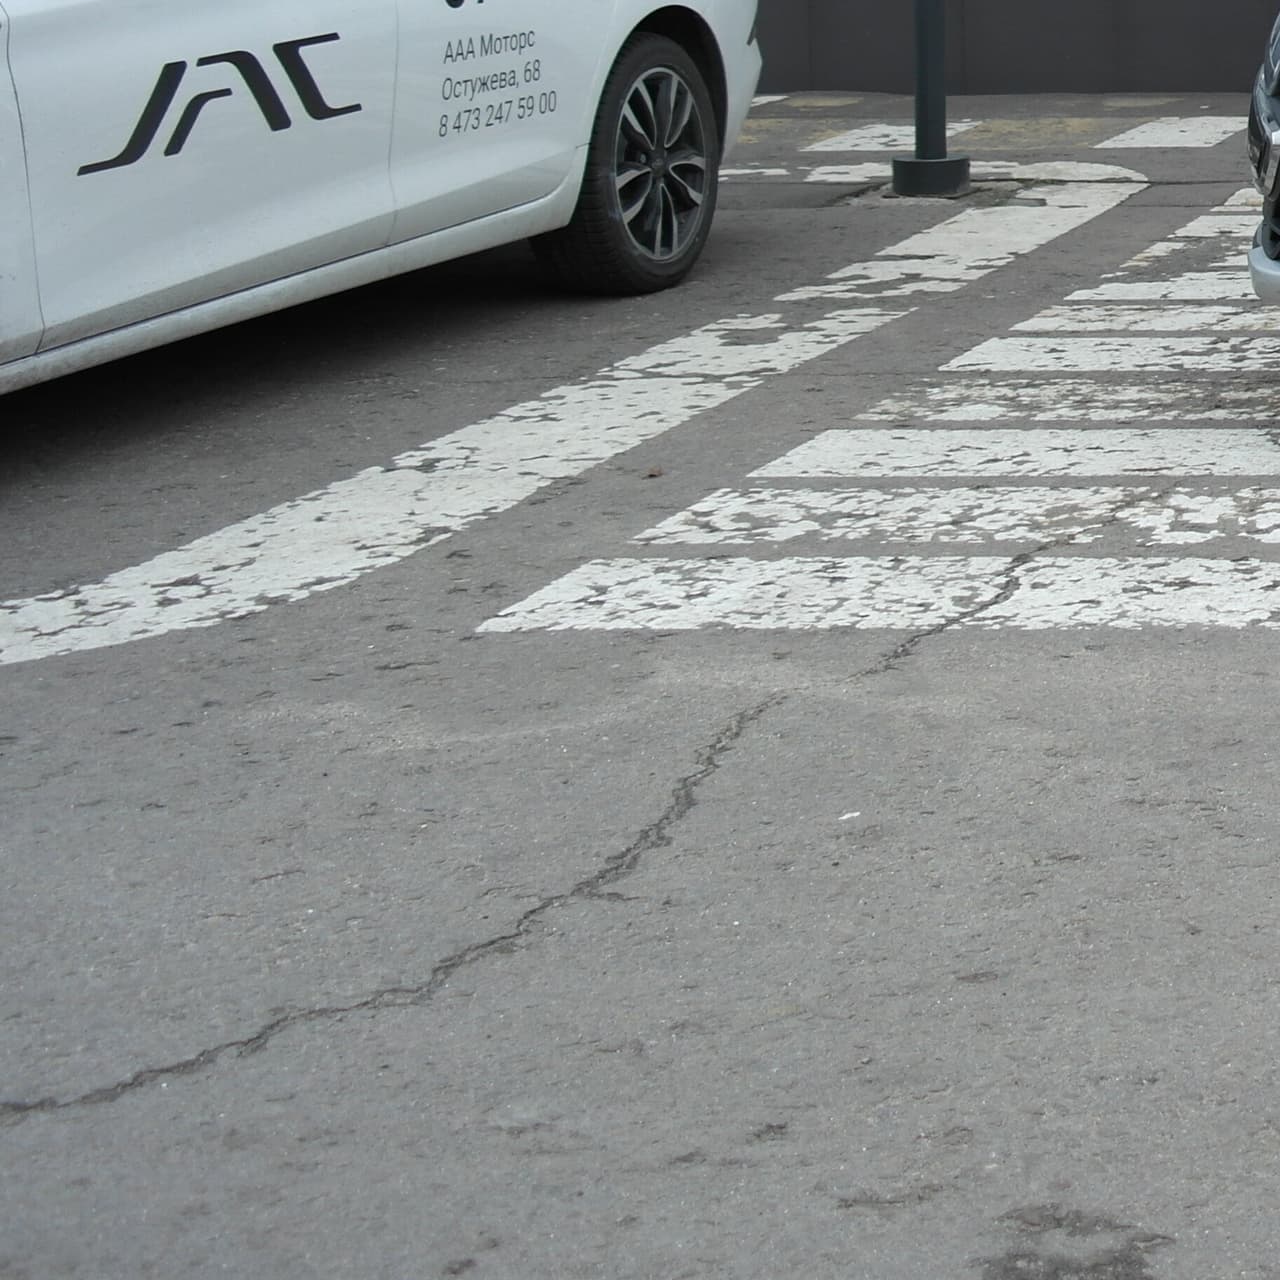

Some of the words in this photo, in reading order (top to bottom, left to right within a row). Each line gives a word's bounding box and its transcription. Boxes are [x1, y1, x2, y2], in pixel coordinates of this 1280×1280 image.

[480, 30, 535, 56] Моторс
[442, 70, 519, 101] Остужева,
[523, 59, 540, 83] 68
[77, 32, 362, 177] JAC
[439, 114, 448, 137] 8
[452, 107, 480, 133] 473
[485, 100, 513, 127] 247
[517, 95, 534, 120] 59
[539, 90, 557, 115] 00
